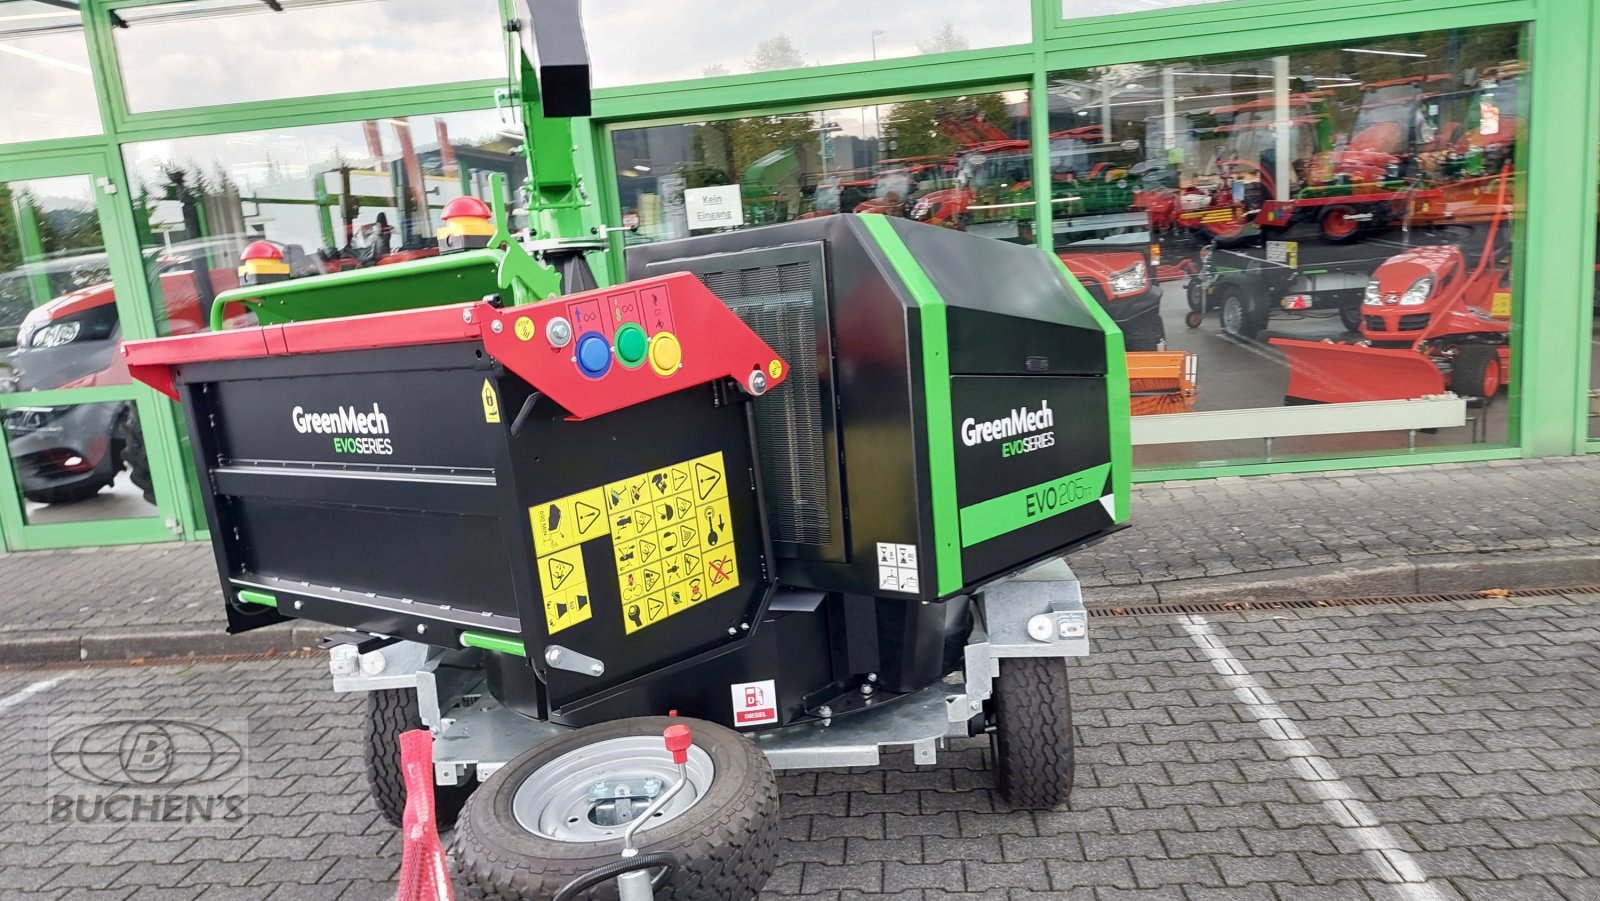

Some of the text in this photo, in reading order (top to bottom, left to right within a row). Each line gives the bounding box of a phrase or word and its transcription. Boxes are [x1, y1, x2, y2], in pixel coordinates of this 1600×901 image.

[702, 194, 723, 204] Kein
[292, 402, 390, 434] GreenMech
[961, 399, 1054, 447] GreenMech
[744, 711, 767, 719] DIESEL
